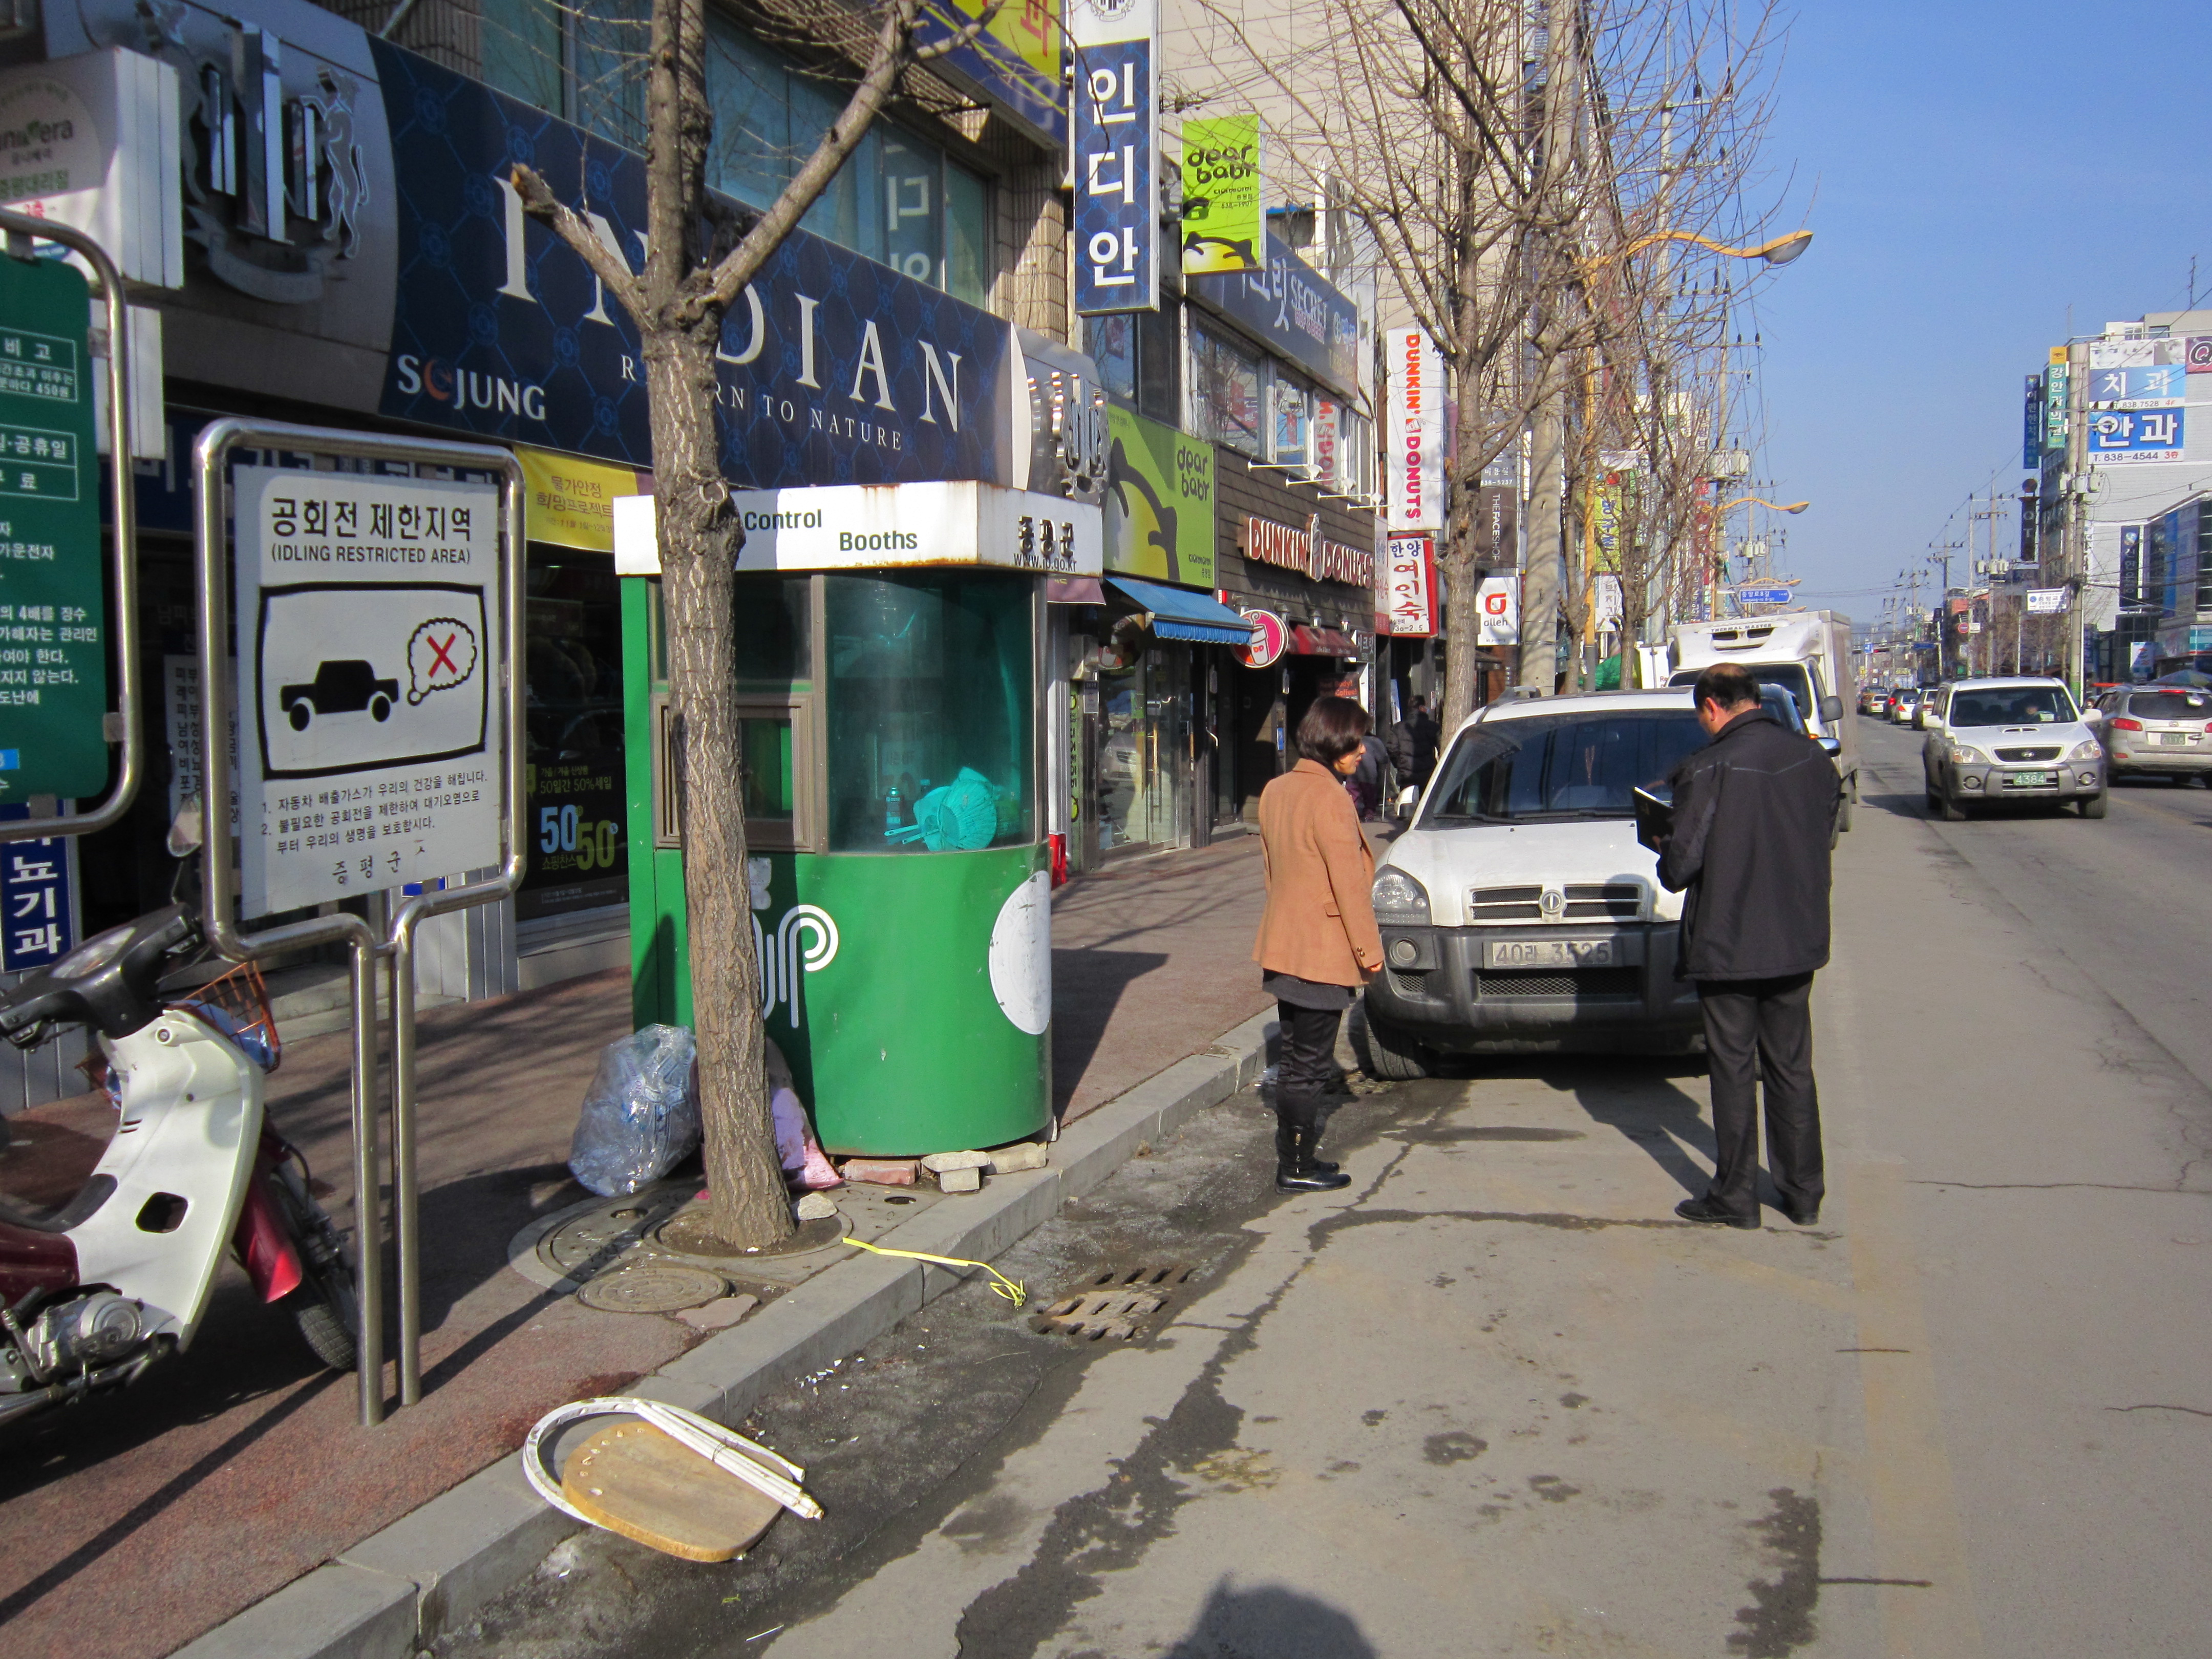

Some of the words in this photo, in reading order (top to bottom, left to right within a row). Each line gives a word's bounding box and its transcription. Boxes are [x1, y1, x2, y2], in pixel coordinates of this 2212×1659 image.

[1088, 62, 1138, 287] 인디안
[2102, 369, 2173, 398] 치과
[763, 394, 793, 421] TO
[811, 408, 901, 451] NATURE
[2099, 414, 2178, 447] 안과
[1178, 444, 1208, 476] dear
[2104, 452, 2159, 460] 838-4544
[551, 476, 602, 498] 물가안정
[1406, 436, 1420, 520] DONUTS
[272, 498, 356, 538] 공회전
[370, 503, 471, 541] 제한지역
[537, 492, 613, 518] 희망프로젝트
[744, 509, 822, 530] Control
[840, 530, 917, 551] Booths
[1018, 515, 1075, 558] 증평군
[271, 543, 330, 562] (IDLING
[336, 546, 425, 563] RESTRICTED
[431, 548, 470, 564] AREA)
[1014, 553, 1077, 572] www.jp.go.kr
[1249, 517, 1310, 570] DUNKIN'
[1323, 540, 1373, 588] DONUTS
[1390, 540, 1421, 558] 한양
[59, 627, 97, 642] 관리인
[1484, 618, 1507, 626] olleh
[36, 648, 69, 664] 한다.
[32, 669, 79, 685] 않는다.
[279, 795, 312, 811] 자동차
[319, 786, 372, 805] 배출가스가
[378, 781, 408, 796] 우리의
[414, 776, 442, 792] 건강을
[448, 771, 487, 786] 해칩니다.
[541, 779, 571, 794] 50일간
[2015, 773, 2045, 784] 4384
[279, 815, 324, 833] 불필요한
[331, 806, 372, 825] 공회전을
[378, 800, 418, 817] 제한하여
[424, 790, 480, 809] 대기오염으로
[277, 837, 299, 854] 부터
[307, 833, 339, 848] 우리의
[346, 826, 376, 844] 생명을
[383, 817, 435, 836] 보호합시다.
